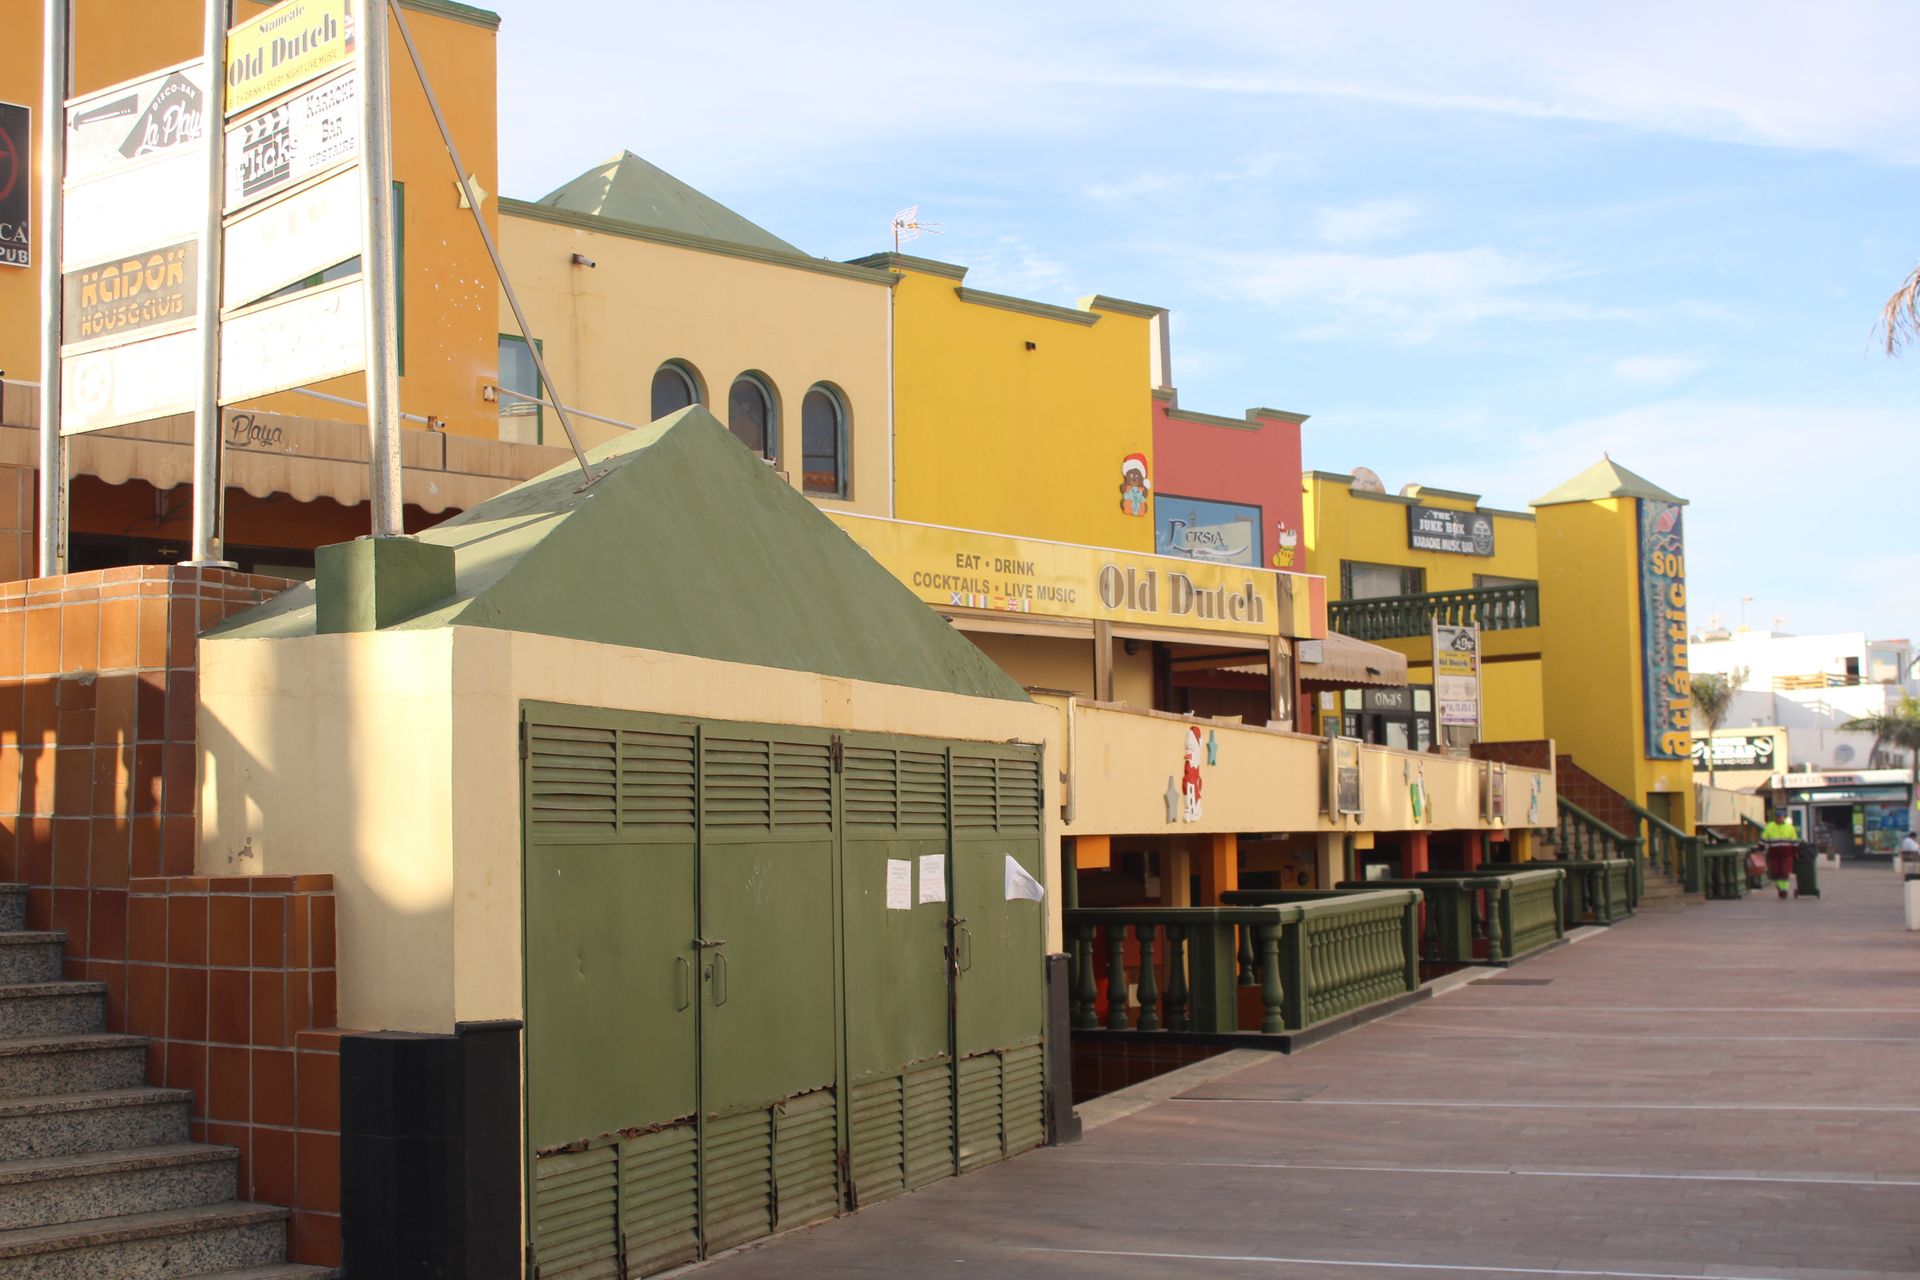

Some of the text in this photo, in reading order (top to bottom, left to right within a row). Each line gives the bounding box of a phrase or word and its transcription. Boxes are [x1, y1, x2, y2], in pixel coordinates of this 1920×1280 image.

[229, 12, 337, 88] Old Dutch
[304, 58, 319, 73] LIVE
[319, 47, 338, 66] MUSIC
[306, 78, 354, 119] KARAOKE
[321, 116, 343, 143] BAR
[308, 136, 355, 168] UPSTAIRS
[231, 414, 284, 447] Playa
[1418, 518, 1466, 535] JUKE BOX
[956, 553, 1035, 577] EAT DRINK
[1651, 551, 1685, 579] SOL
[913, 571, 1076, 604] COCKTAILS LIVE MUSIC
[1098, 564, 1265, 624] Old Dutch
